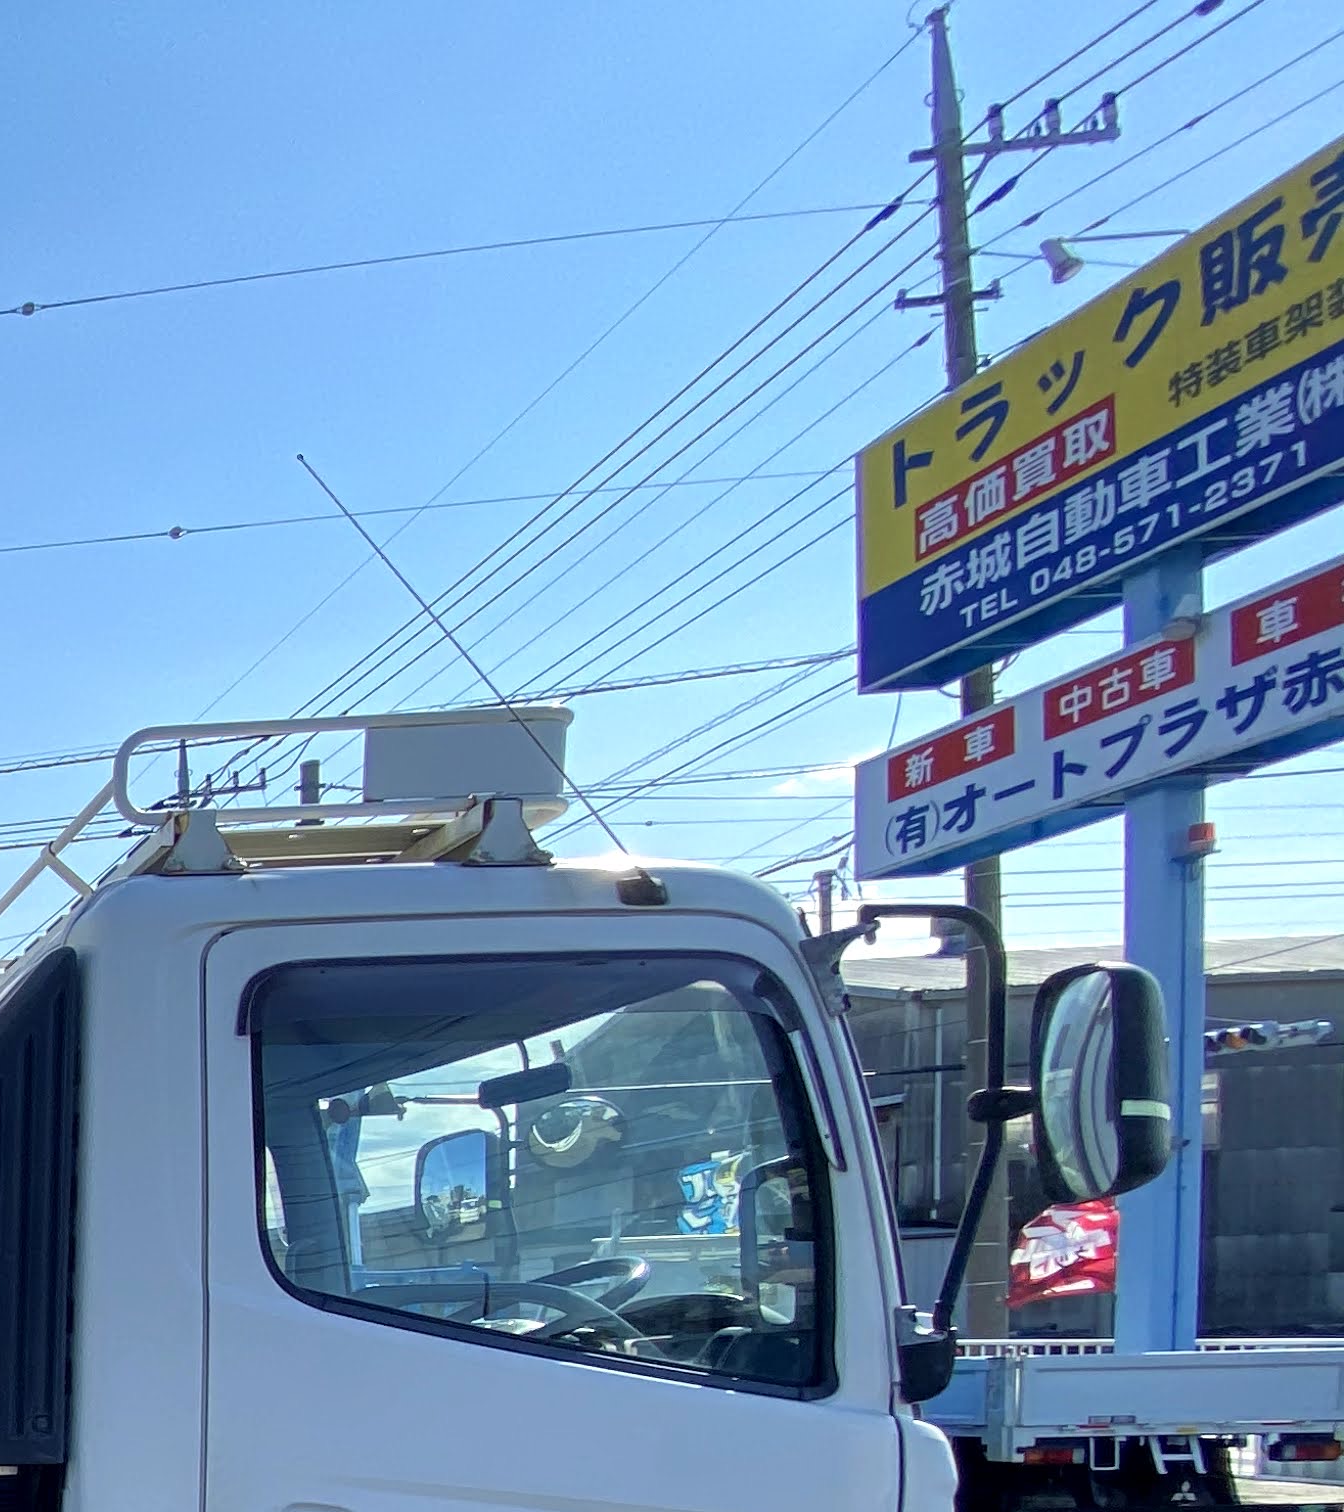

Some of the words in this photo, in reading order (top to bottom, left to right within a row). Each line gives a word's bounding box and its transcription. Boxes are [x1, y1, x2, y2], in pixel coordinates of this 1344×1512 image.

[918, 408, 1111, 553] 高価買取
[960, 588, 1018, 628] TEL
[1030, 440, 1307, 596] 048-571-2371
[1058, 647, 1178, 723] 中古車
[904, 723, 995, 788] 新車
